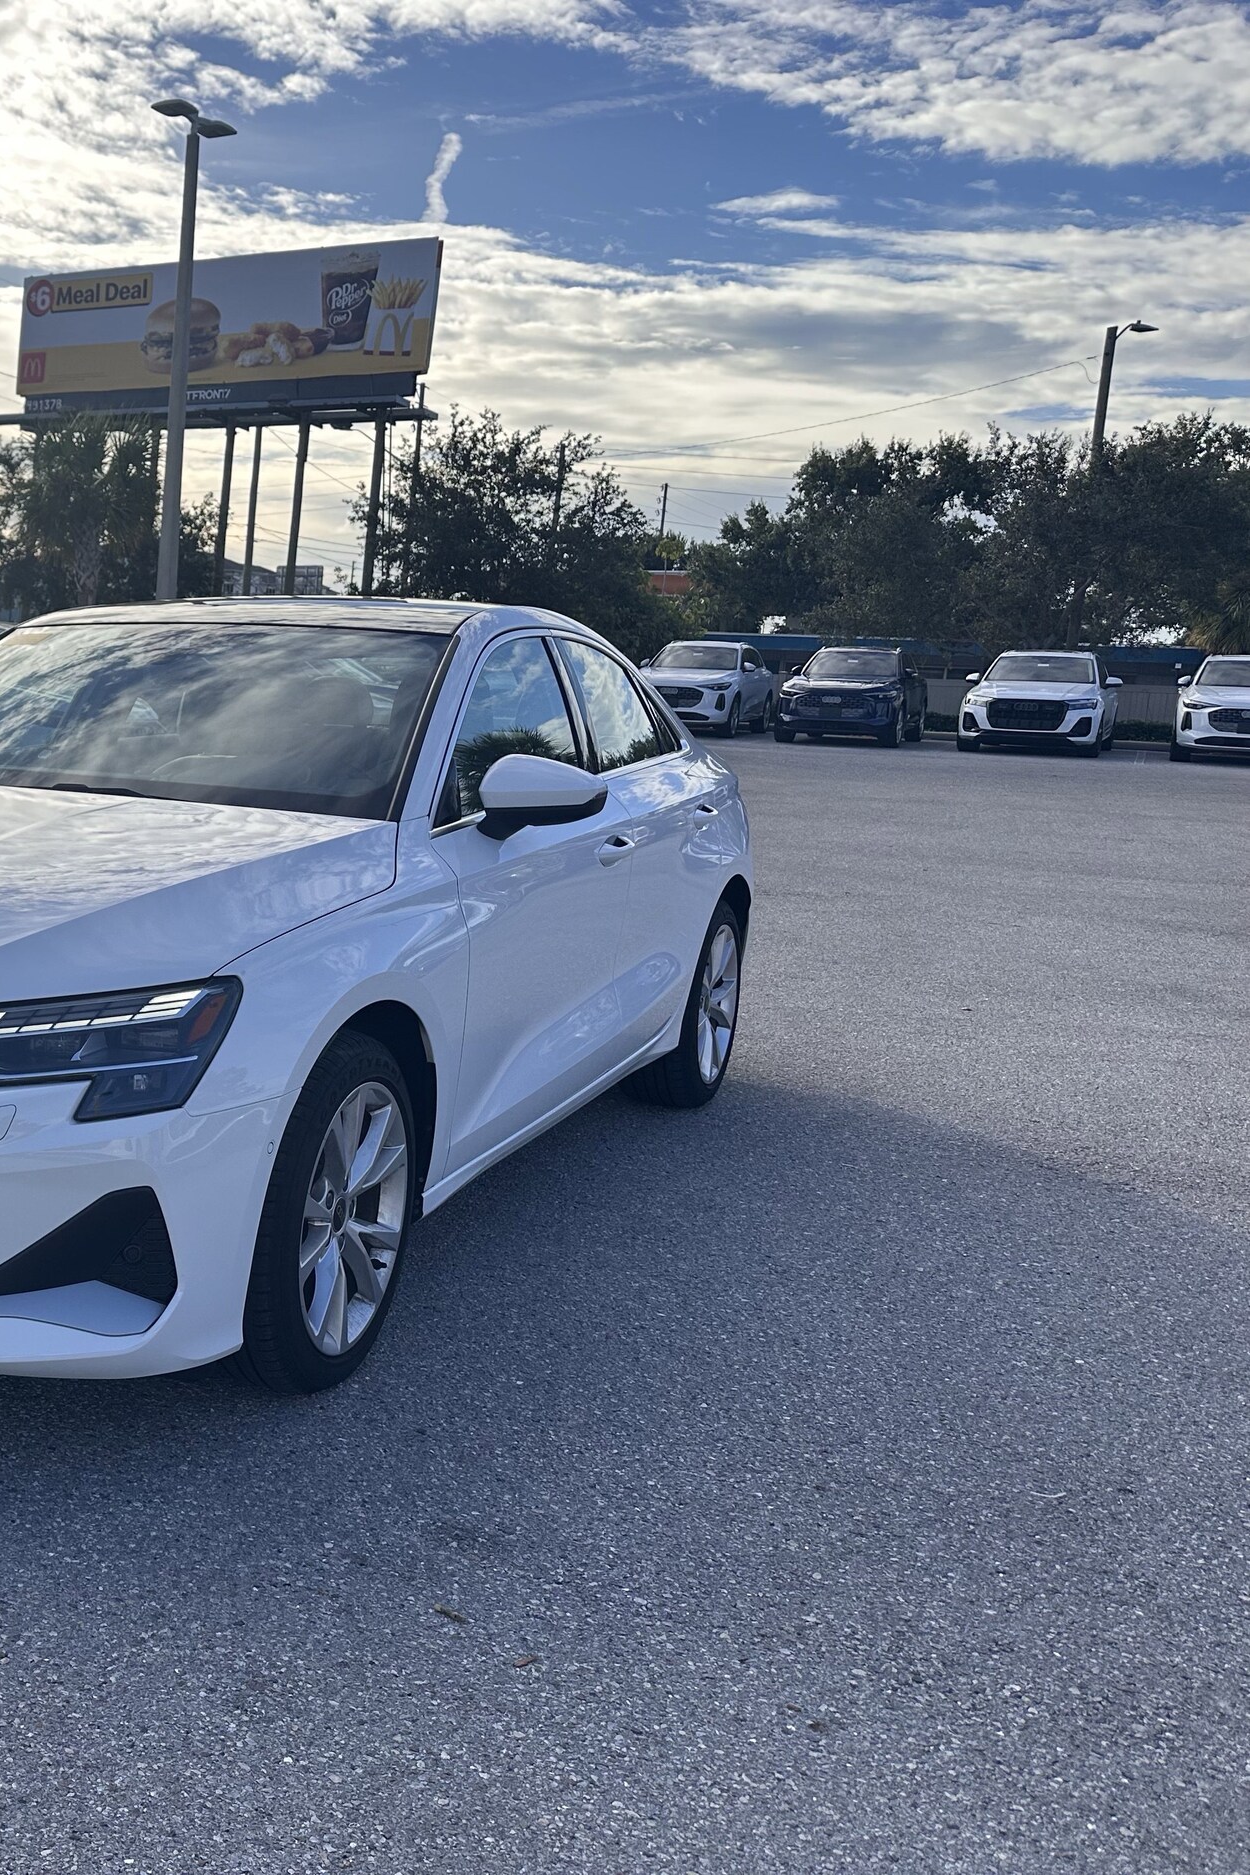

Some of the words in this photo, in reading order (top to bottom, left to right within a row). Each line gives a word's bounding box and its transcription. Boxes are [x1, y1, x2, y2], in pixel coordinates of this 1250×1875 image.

[30, 286, 51, 311] $6
[56, 281, 101, 306] Meal
[105, 278, 148, 302] Deal
[330, 286, 367, 310] Pepper
